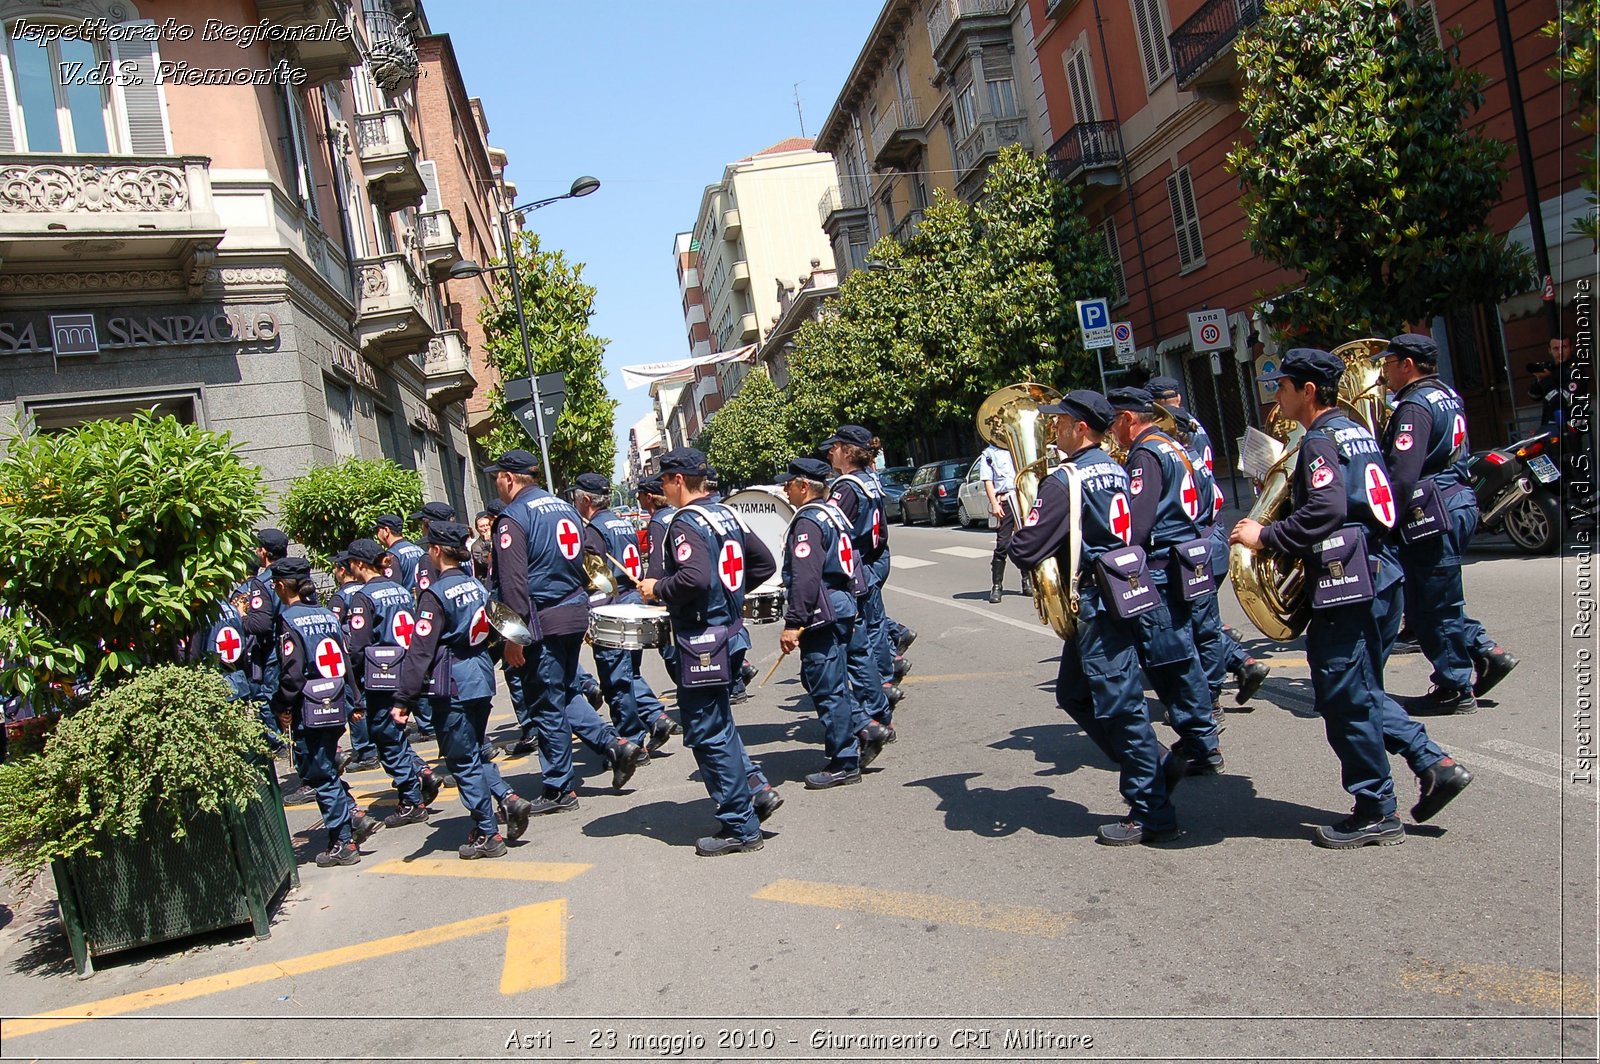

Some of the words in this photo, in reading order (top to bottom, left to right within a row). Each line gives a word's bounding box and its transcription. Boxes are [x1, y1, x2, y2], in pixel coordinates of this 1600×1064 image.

[1198, 314, 1218, 322] zona
[108, 311, 280, 348] SANPAOLO
[1204, 329, 1216, 339] 30
[740, 504, 776, 514] YAMAHA
